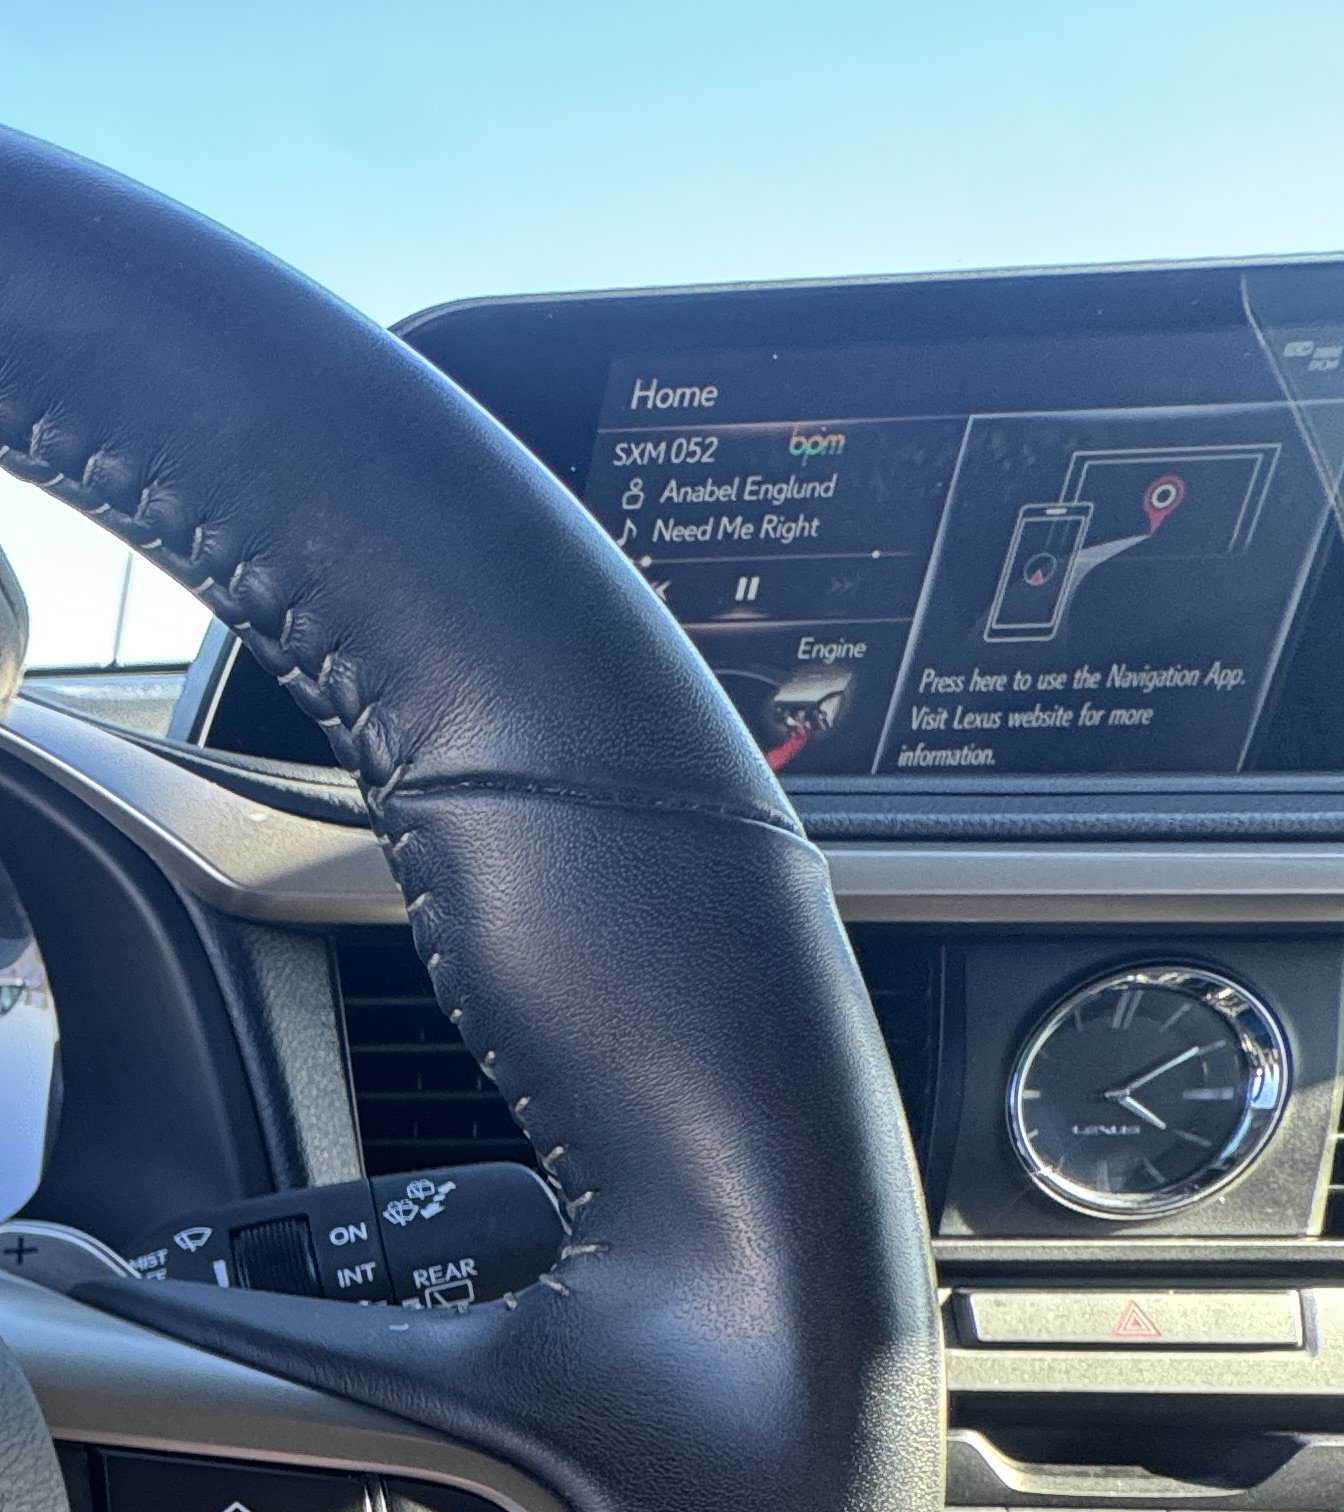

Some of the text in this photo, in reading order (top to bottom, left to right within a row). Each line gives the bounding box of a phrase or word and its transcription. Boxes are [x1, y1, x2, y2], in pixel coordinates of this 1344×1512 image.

[630, 378, 718, 409] Home
[613, 437, 718, 466] SXM 052
[788, 424, 846, 467] bpm
[659, 473, 839, 506] Anabel Englund
[652, 513, 821, 545] Need Me Right
[796, 636, 868, 664] Engine
[918, 661, 1246, 694] Press here to use the Navigation App.
[910, 702, 1155, 731] Visit Lexus website for more
[897, 743, 996, 768] information.
[1072, 1125, 1140, 1135] LEXUS
[329, 1222, 369, 1246] ON
[337, 1261, 376, 1289] INT
[413, 1258, 478, 1289] REAR
